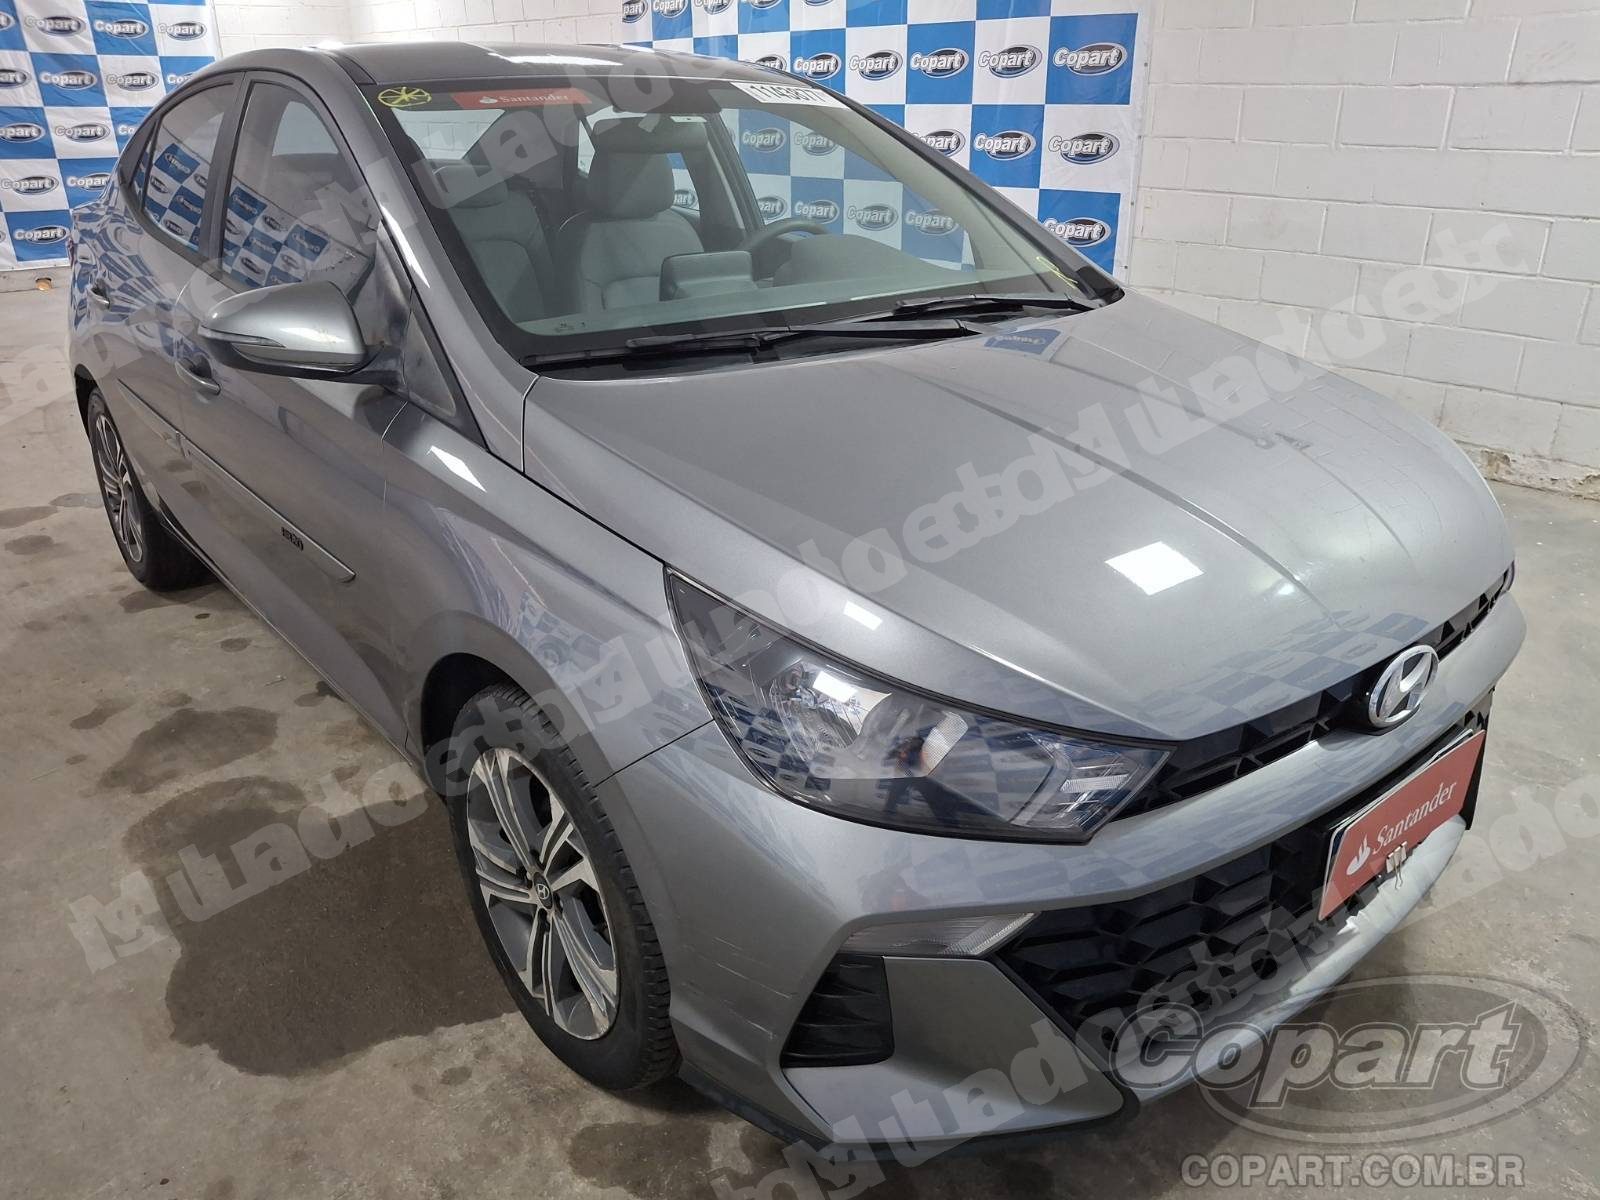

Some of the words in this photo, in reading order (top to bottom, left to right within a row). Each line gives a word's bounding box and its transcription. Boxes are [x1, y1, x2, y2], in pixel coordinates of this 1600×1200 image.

[622, 2, 643, 15] part
[24, 16, 78, 32] Copart
[94, 20, 143, 35] Copart
[158, 24, 201, 37] Copart
[794, 57, 836, 75] Copart
[849, 54, 896, 74] Copart
[910, 53, 961, 73] Copart
[978, 50, 1033, 73] Copart
[1054, 46, 1119, 71] Copart
[40, 72, 91, 87] Copart
[106, 73, 153, 88] Copart
[500, 94, 569, 104] Santander
[55, 125, 104, 139] Copart
[742, 131, 780, 148] Copart
[974, 133, 1033, 155] Copart
[1048, 135, 1112, 157] Copart
[1, 178, 50, 191] Copart
[67, 176, 109, 189] Copar
[794, 202, 835, 219] Copart
[847, 206, 892, 224] Copart
[905, 210, 953, 230] Copart
[14, 228, 63, 241] Copart
[1373, 782, 1457, 855] Santander
